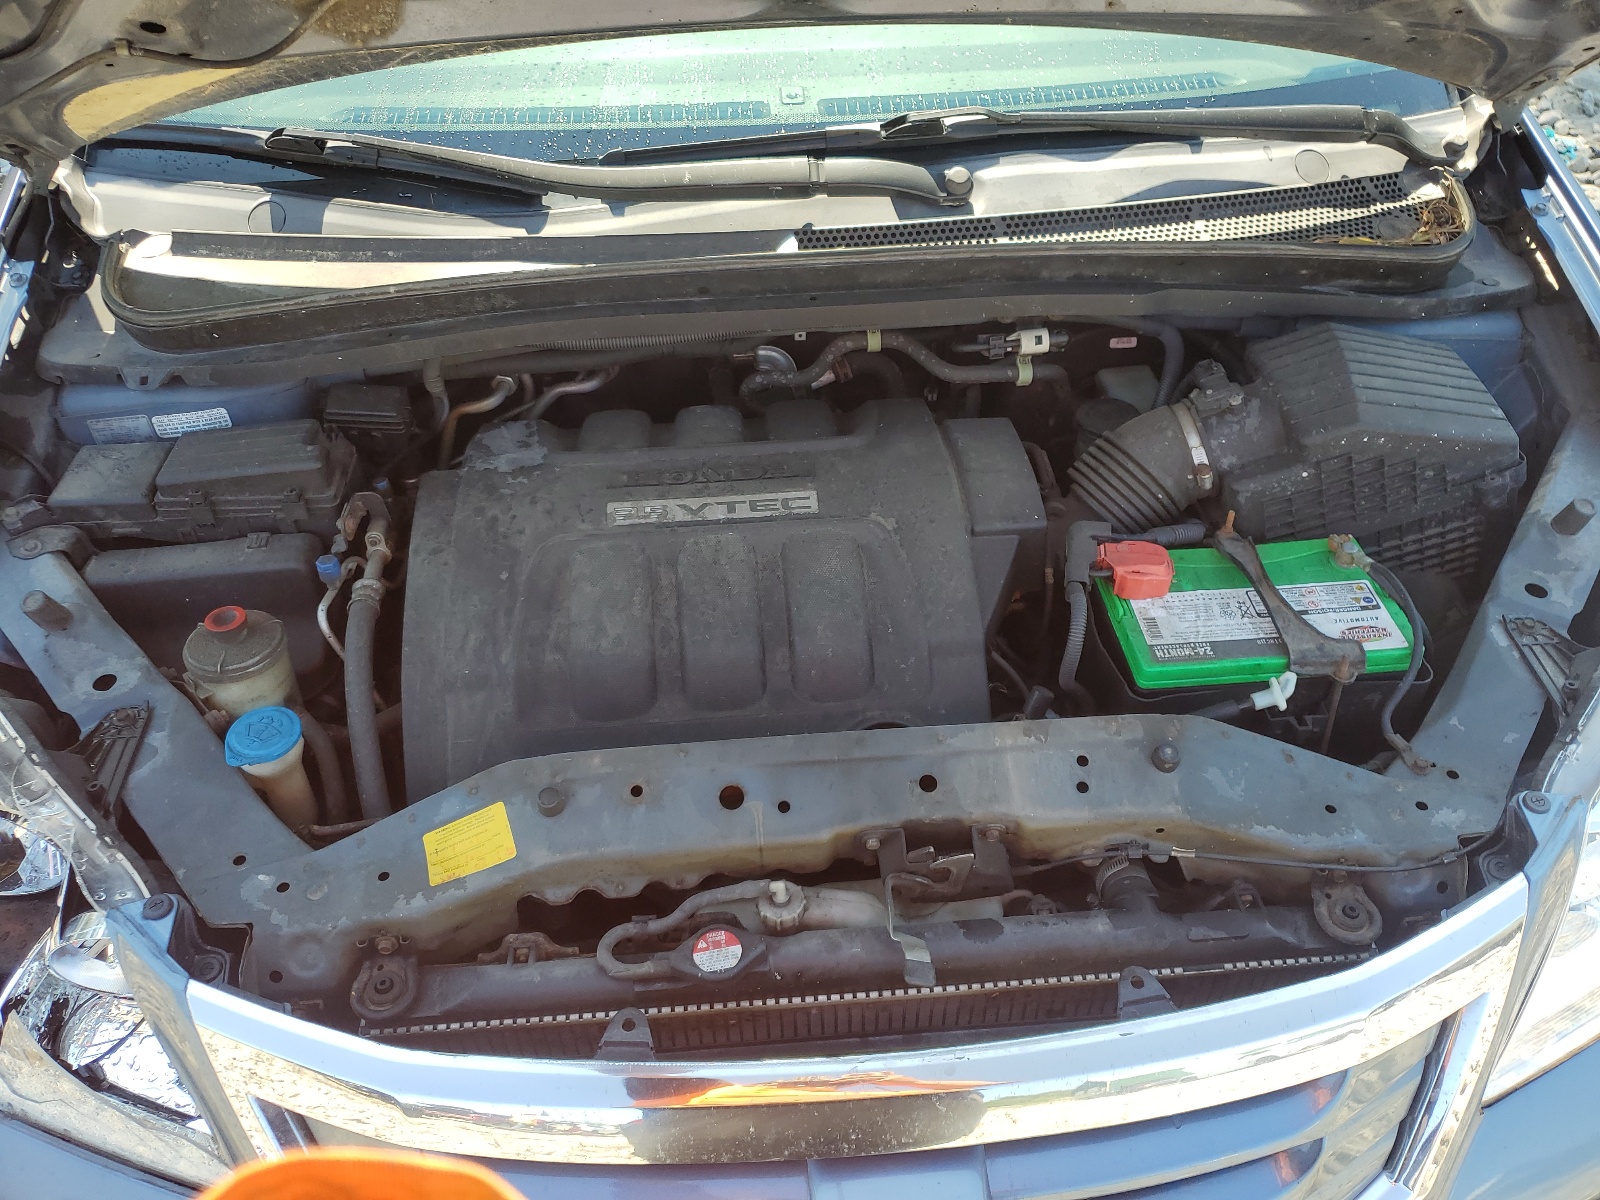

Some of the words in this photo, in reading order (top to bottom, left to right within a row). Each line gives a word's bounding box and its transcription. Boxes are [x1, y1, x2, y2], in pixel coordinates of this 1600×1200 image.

[675, 495, 812, 517] VTEC
[1334, 616, 1379, 624] AUTOMOTIVE
[1154, 646, 1214, 659] 24-MONTH
